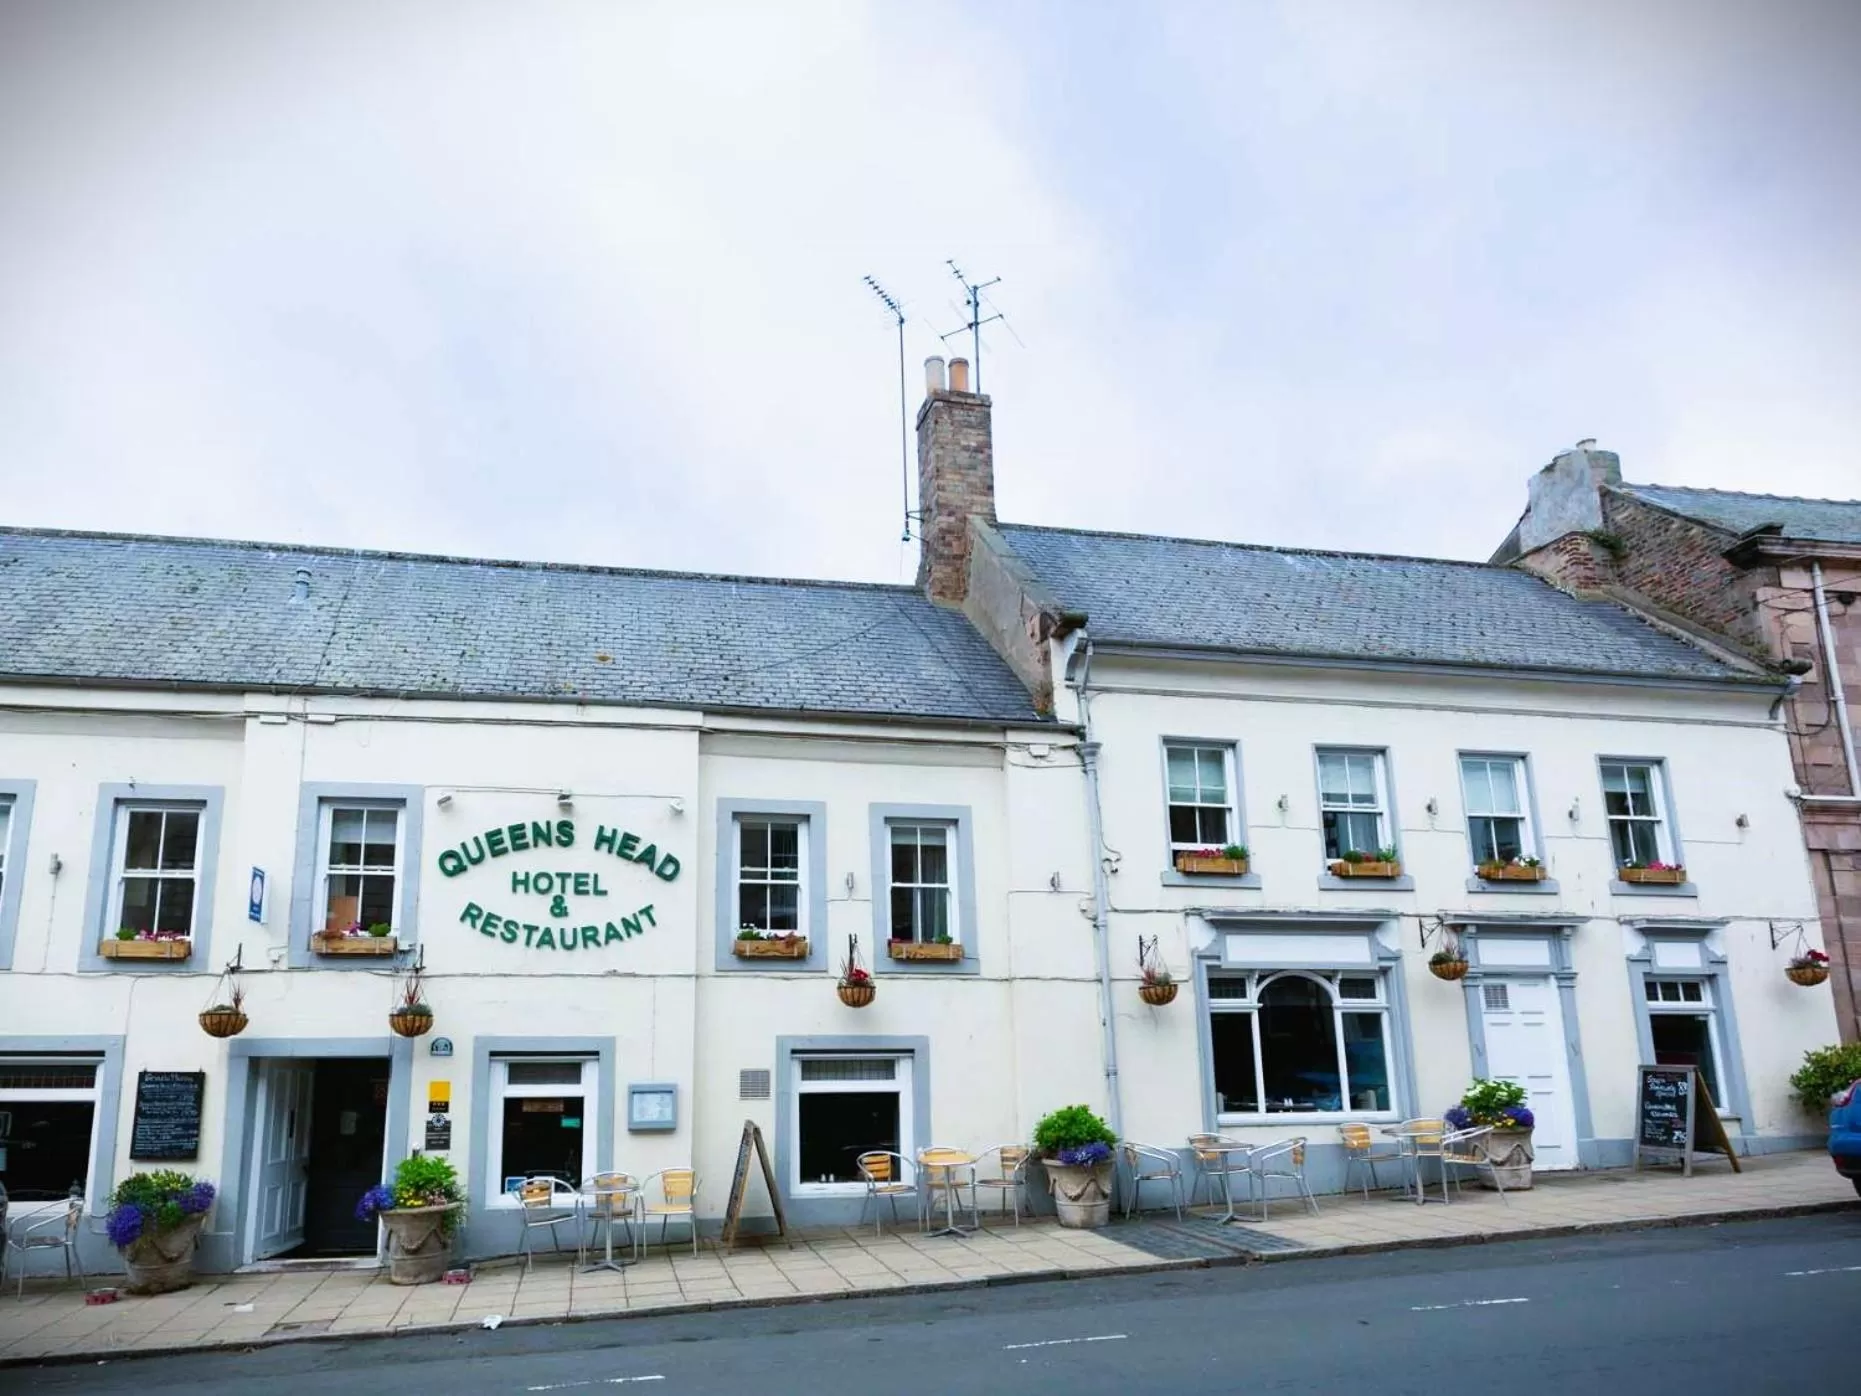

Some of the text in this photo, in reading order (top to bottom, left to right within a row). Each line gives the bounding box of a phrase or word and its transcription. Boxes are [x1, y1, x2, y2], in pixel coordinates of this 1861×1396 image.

[438, 820, 681, 882] QUEENS HEAD
[512, 871, 608, 896] HOTEL
[550, 894, 569, 918] &
[459, 902, 657, 951] RESTAURANT
